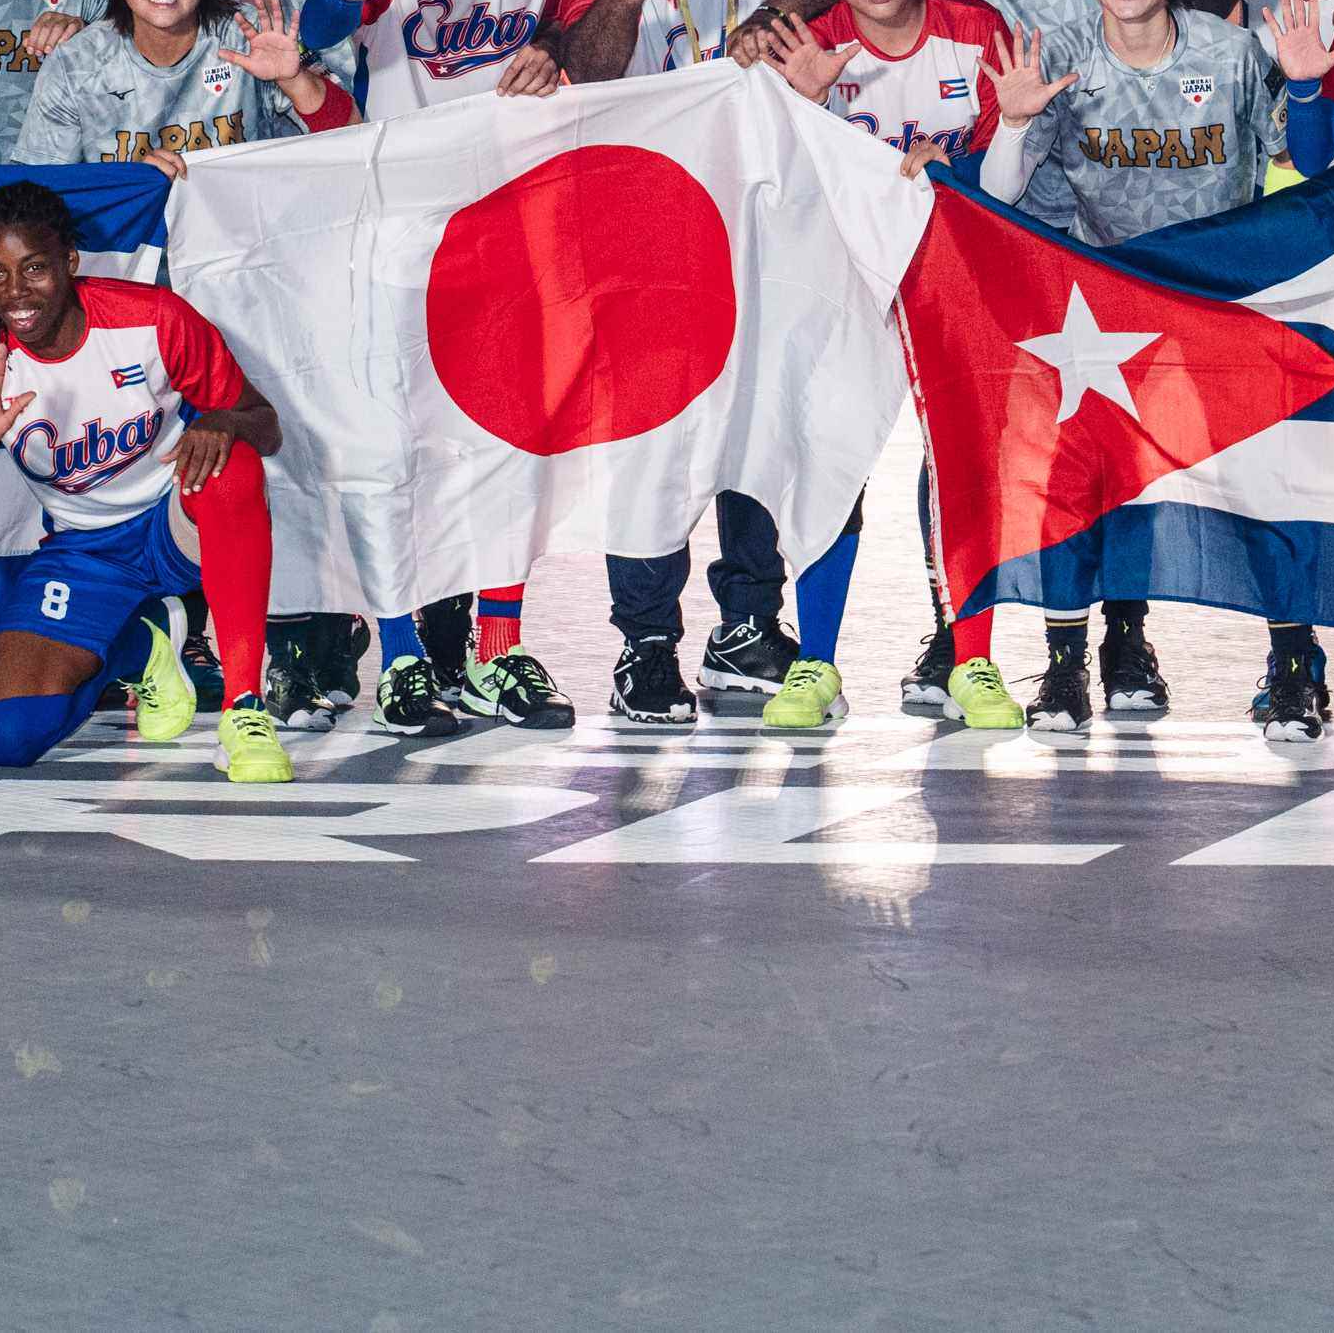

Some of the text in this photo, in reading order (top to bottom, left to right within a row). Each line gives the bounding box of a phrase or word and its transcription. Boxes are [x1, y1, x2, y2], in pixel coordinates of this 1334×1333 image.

[204, 72, 232, 85] JAPAN
[1183, 82, 1214, 94] JAPAN
[1078, 123, 1226, 169] JAPAN
[11, 407, 166, 487] Cuba
[40, 580, 71, 620] 8
